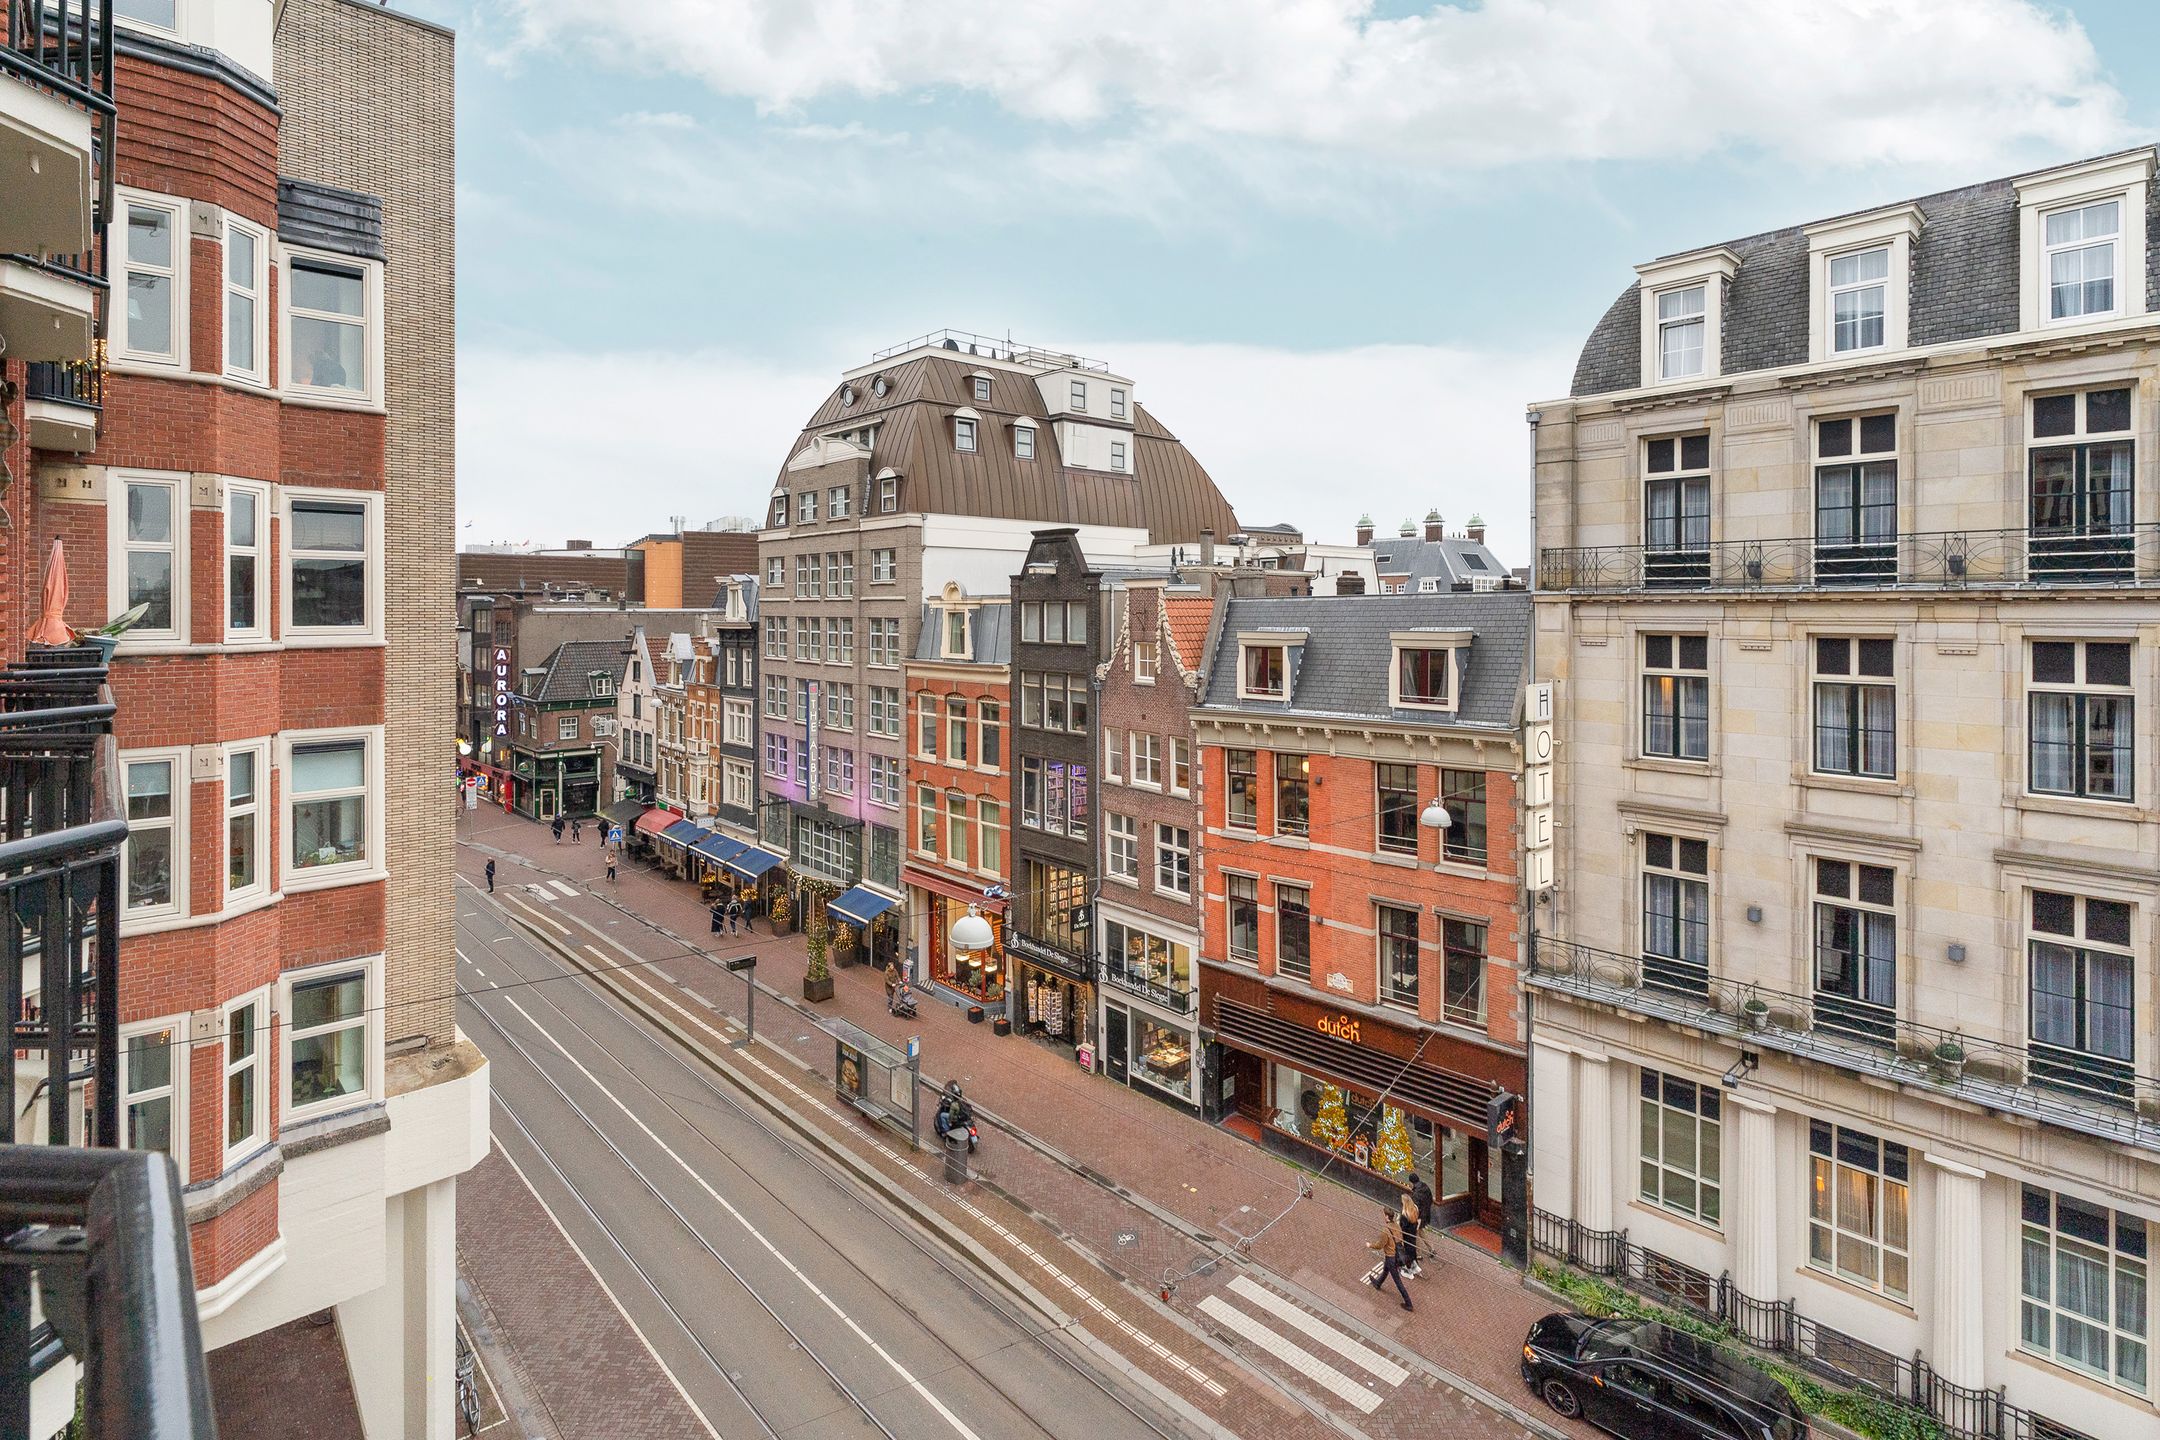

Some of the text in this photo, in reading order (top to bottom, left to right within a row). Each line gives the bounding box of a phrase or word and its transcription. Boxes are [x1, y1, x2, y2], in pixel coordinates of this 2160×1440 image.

[496, 649, 507, 735] AURORA
[809, 740, 817, 795] ALBUS
[1537, 689, 1550, 885] HOTEL
[1046, 948, 1055, 958] De
[1142, 984, 1151, 996] De
[1318, 1016, 1360, 1042] dutch
[1496, 1111, 1514, 1134] dutch
